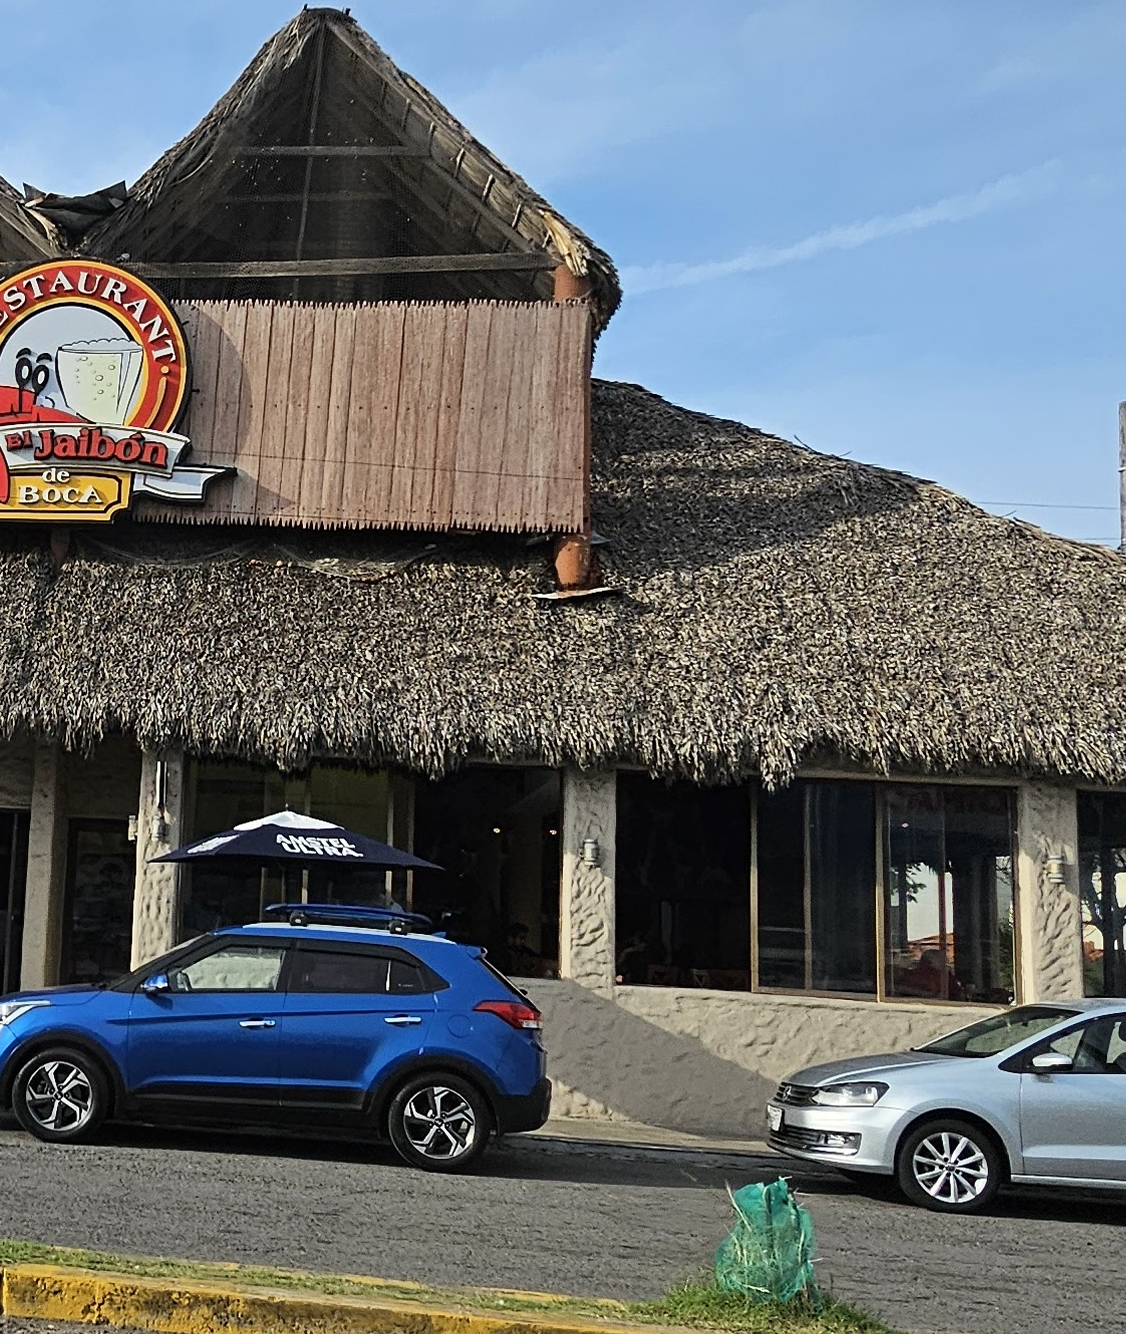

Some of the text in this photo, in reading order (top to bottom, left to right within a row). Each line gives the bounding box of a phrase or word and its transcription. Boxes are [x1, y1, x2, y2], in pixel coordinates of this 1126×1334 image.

[6, 427, 168, 467] El Jaibón
[42, 468, 70, 483] de
[18, 485, 103, 504] BOCA
[276, 834, 356, 849] AMSTEL
